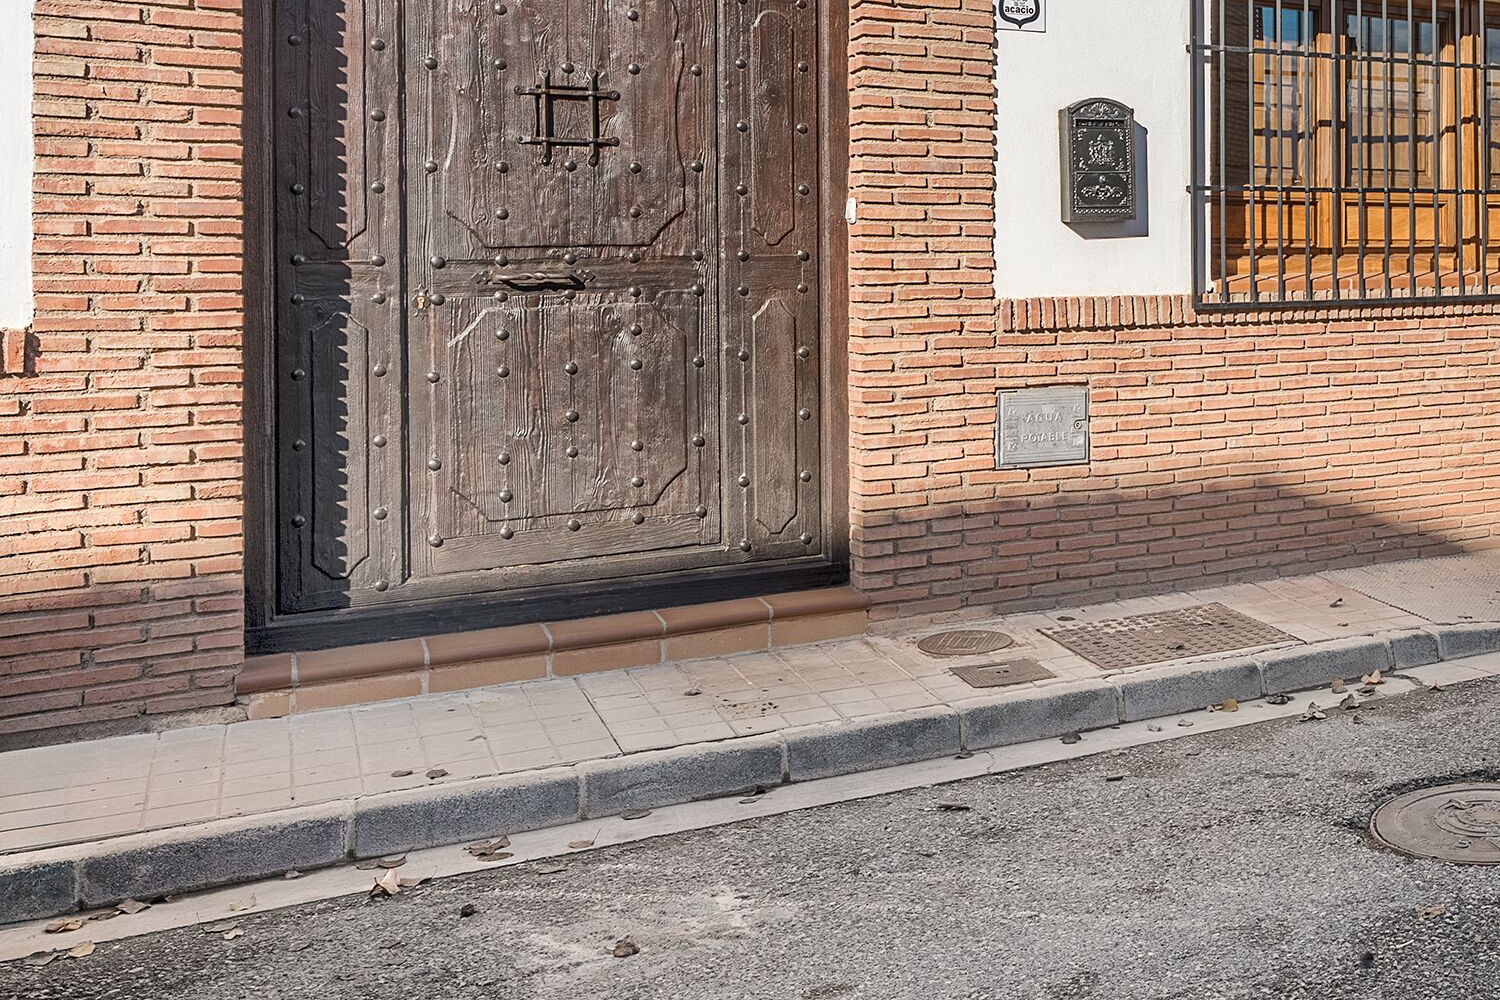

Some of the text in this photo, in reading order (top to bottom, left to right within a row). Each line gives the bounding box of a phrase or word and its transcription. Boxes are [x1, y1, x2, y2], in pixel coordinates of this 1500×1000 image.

[1005, 5, 1034, 14] acacio
[1025, 412, 1063, 423] AGUA
[1020, 432, 1068, 443] POTABLE
